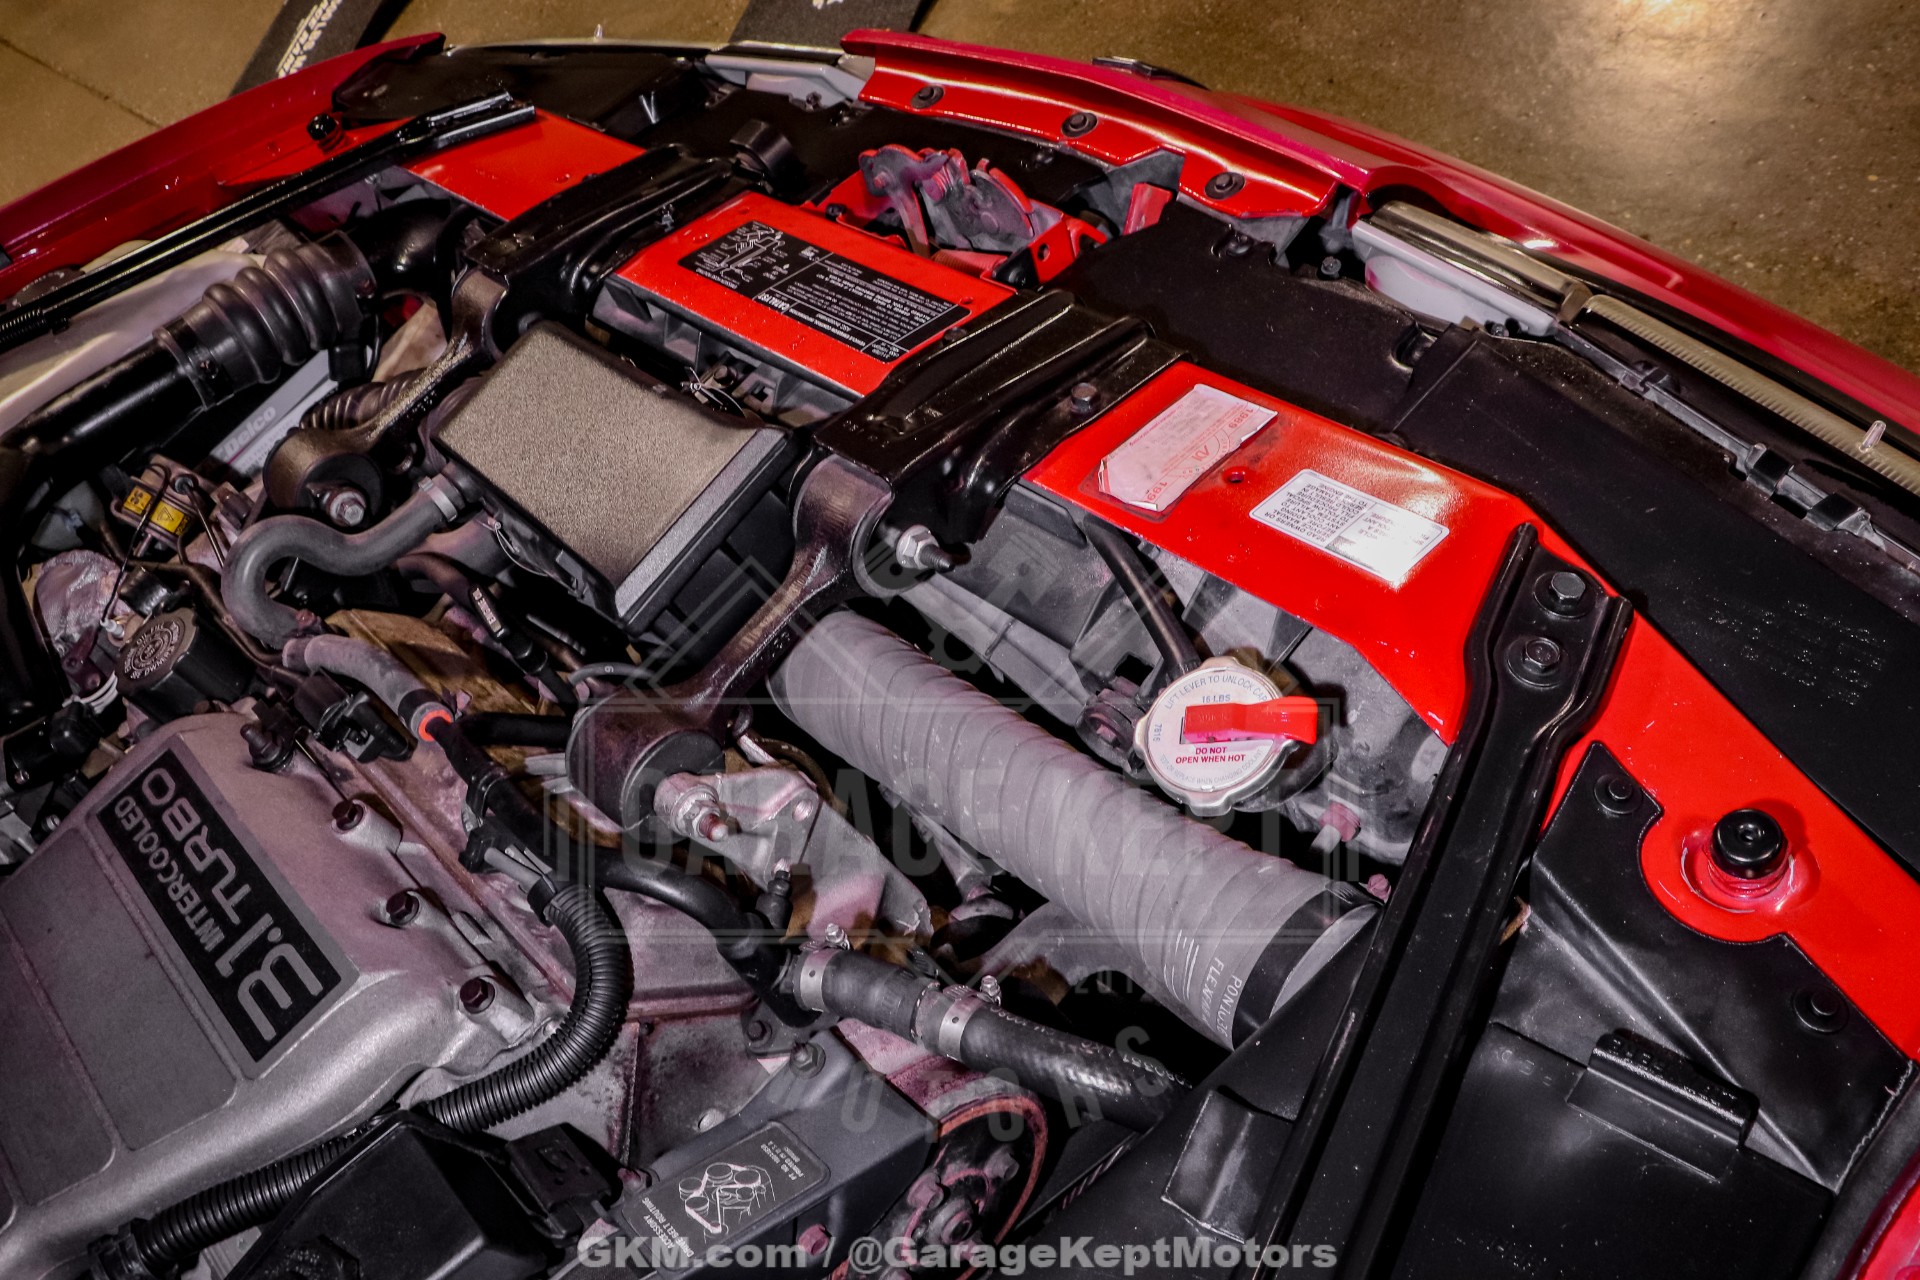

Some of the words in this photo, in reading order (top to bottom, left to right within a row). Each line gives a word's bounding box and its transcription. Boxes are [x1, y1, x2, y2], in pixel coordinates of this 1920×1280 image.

[1228, 406, 1254, 431] 1989
[1164, 694, 1179, 709] LIFT
[1180, 678, 1206, 696] LEVER
[1208, 675, 1220, 684] TO
[1222, 675, 1254, 692] UNLOCK
[1253, 686, 1267, 702] CAP
[1202, 695, 1211, 703] 16
[1213, 694, 1231, 702] LBS
[1175, 756, 1199, 764] OPEN
[1200, 755, 1225, 763] WHEN
[1227, 754, 1246, 762] HOT
[1195, 746, 1207, 755] DO
[1209, 746, 1227, 754] NOT
[141, 766, 253, 926] TURBO
[114, 795, 226, 953] INTERCOOLED
[214, 912, 324, 1043] 3.1
[641, 1196, 666, 1224] ROUTING
[642, 1213, 675, 1249] ACCESSORY
